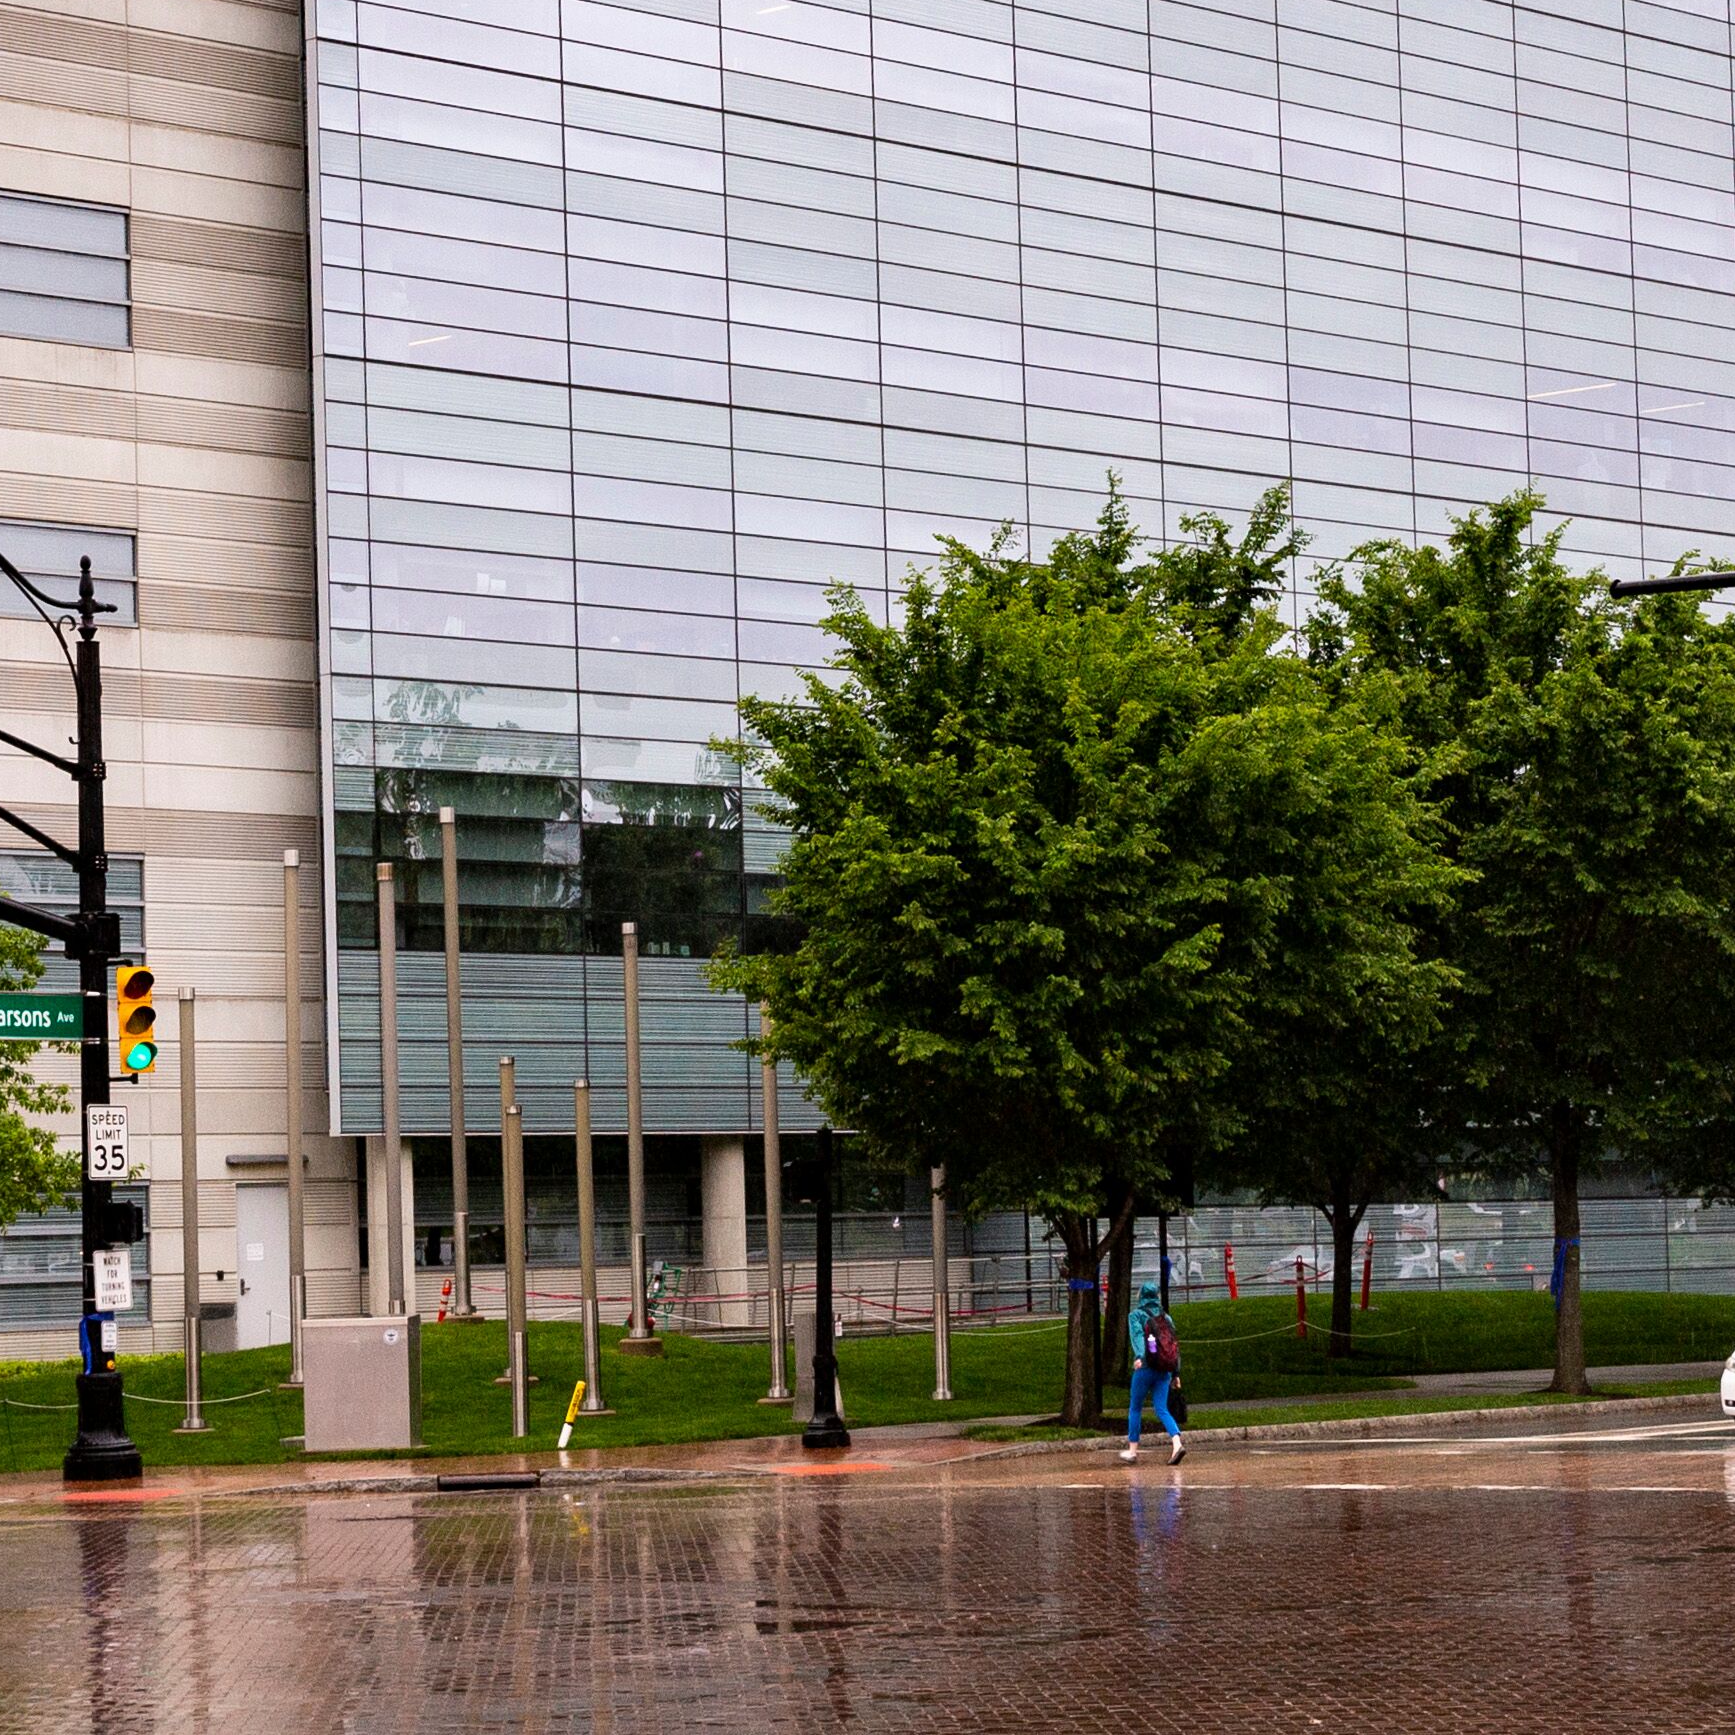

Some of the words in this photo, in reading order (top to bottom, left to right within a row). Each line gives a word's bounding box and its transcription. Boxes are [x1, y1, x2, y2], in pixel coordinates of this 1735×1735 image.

[57, 1011, 75, 1023] Ave
[91, 1114, 125, 1125] SPEED
[95, 1129, 121, 1140] LIMIT
[94, 1145, 125, 1171] 35
[107, 1269, 118, 1278] FOR
[101, 1294, 127, 1304] VEHICLES
